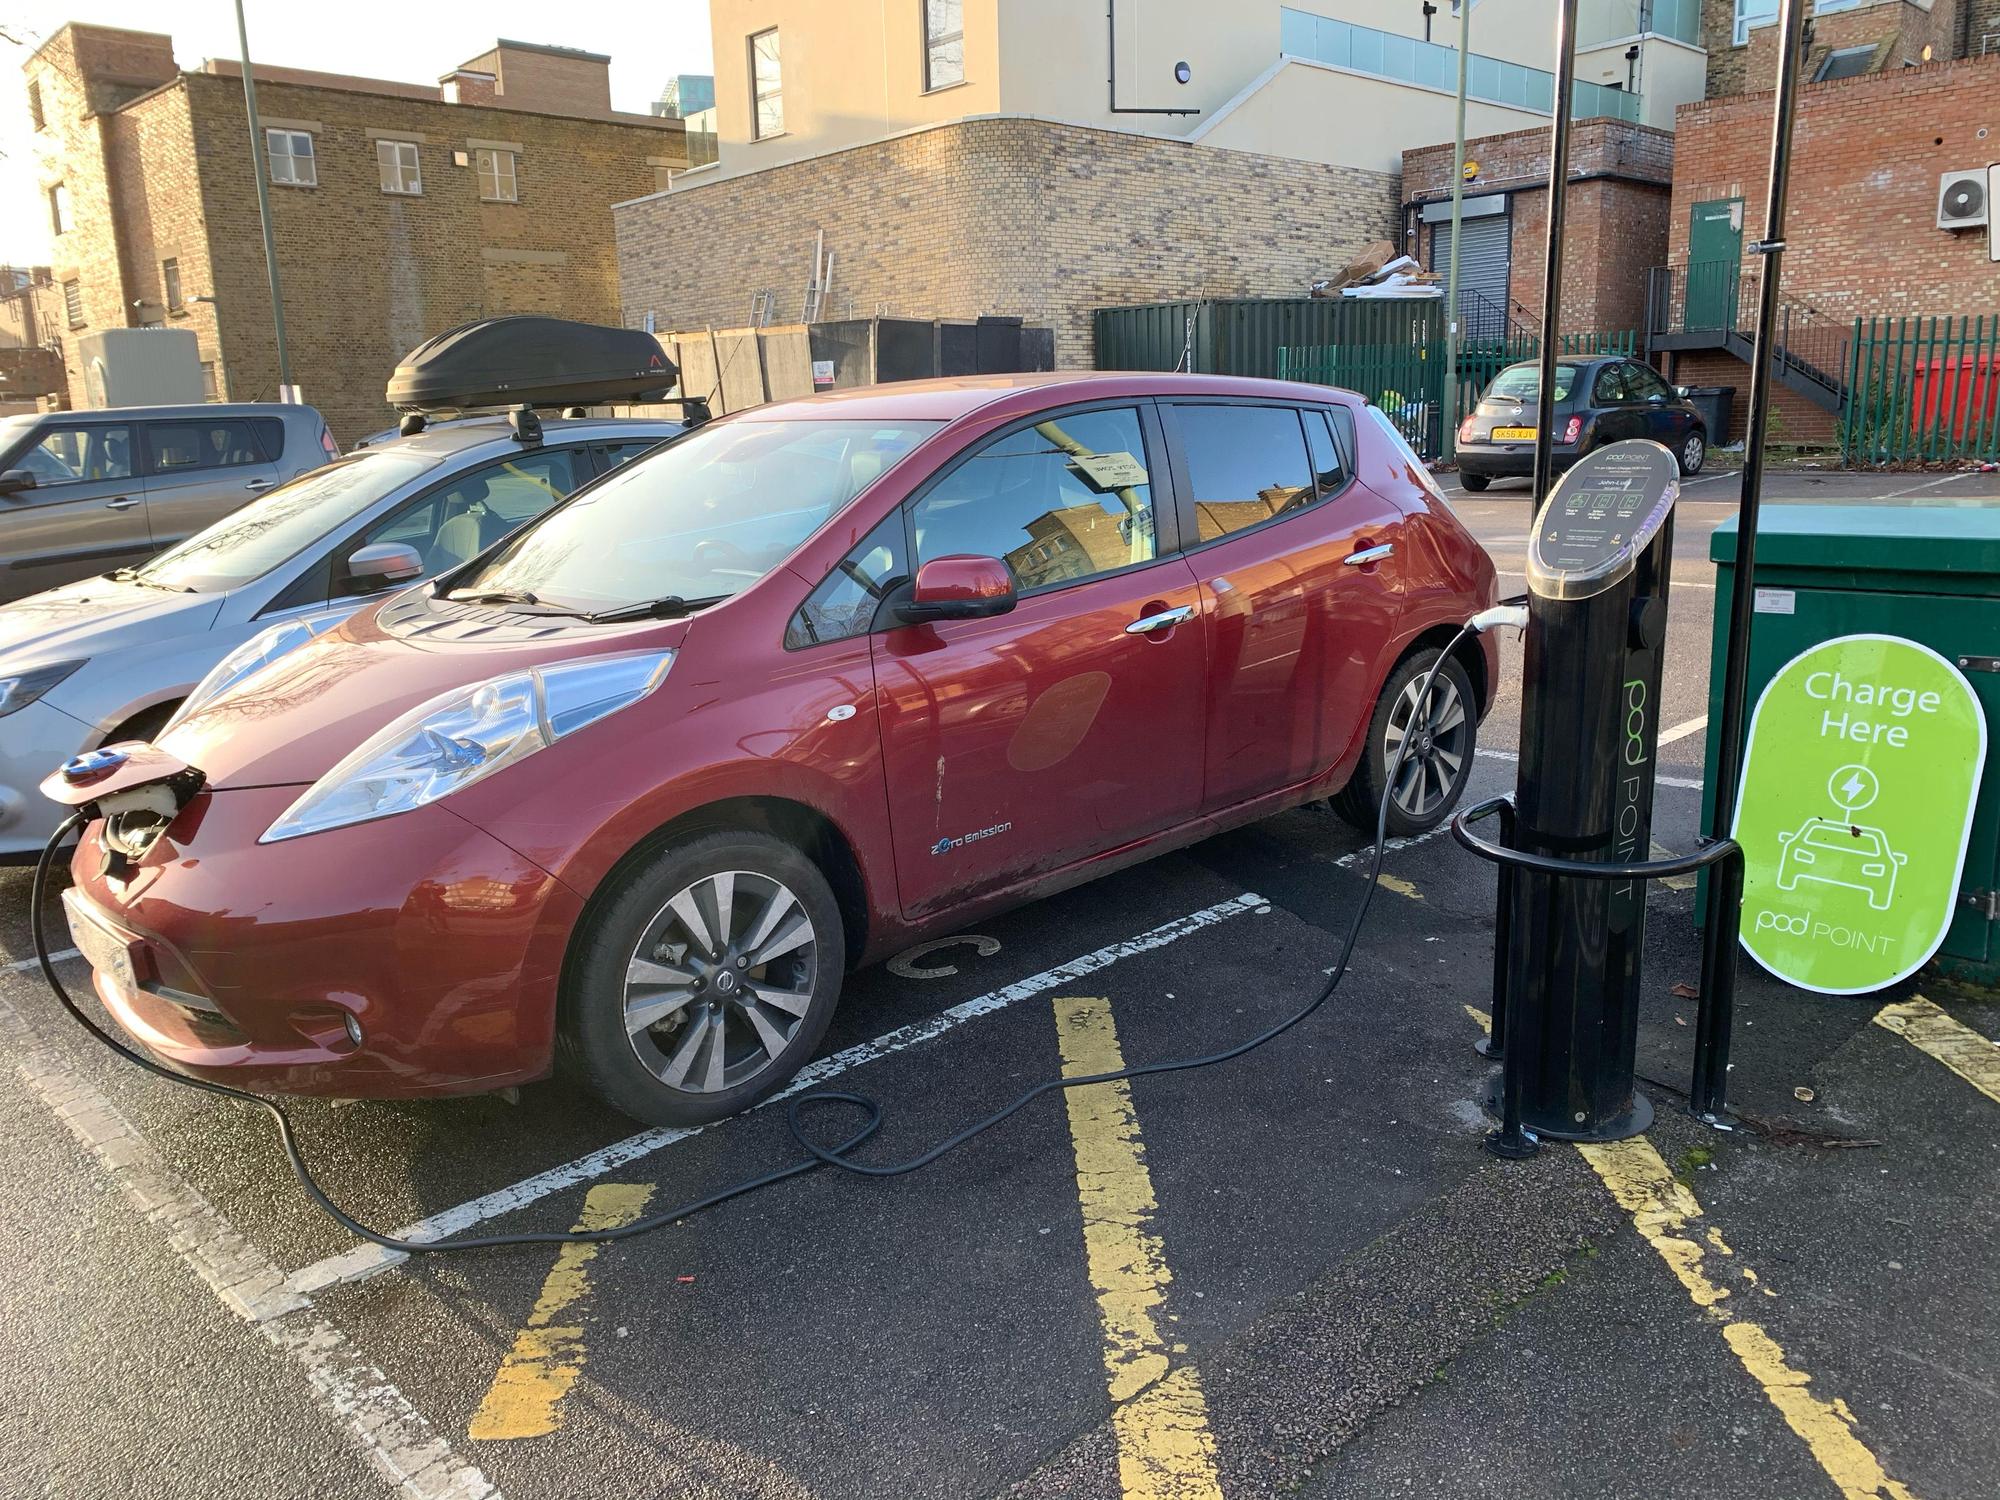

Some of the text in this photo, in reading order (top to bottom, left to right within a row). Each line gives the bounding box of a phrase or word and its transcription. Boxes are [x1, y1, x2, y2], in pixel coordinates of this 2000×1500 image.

[1805, 672, 1941, 717] Charge
[1623, 679, 1649, 766] pod
[1821, 710, 1909, 748] Here
[964, 821, 1012, 844] Emission
[1755, 910, 1897, 957] pod POINT
